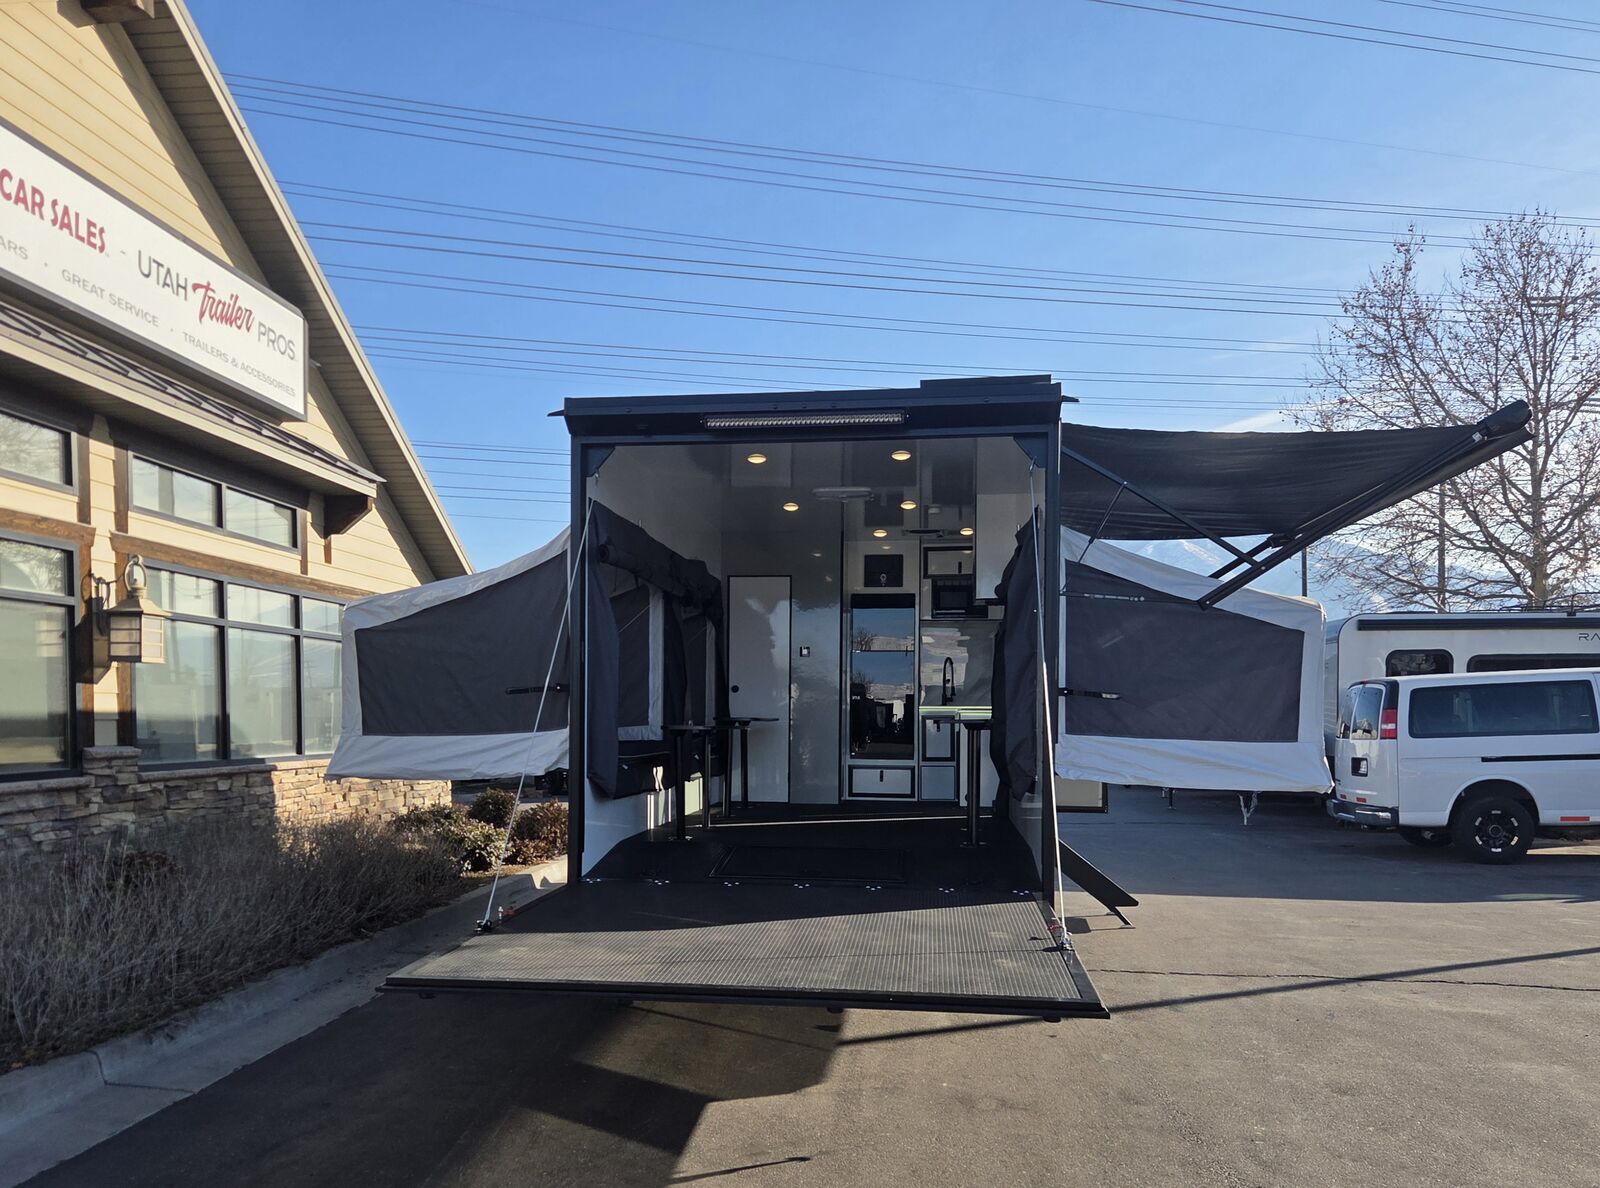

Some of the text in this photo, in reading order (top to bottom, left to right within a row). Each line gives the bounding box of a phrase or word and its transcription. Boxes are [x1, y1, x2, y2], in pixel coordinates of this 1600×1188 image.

[0, 168, 45, 221] CAR
[50, 198, 106, 254] SALES
[138, 249, 188, 301] UTAH
[191, 280, 255, 333] Trailer
[257, 320, 296, 361] PROS
[61, 268, 106, 299] GREAT
[108, 292, 160, 328] SERVICE
[182, 331, 229, 364] TRAILERS
[240, 362, 296, 398] ACCESSORIES
